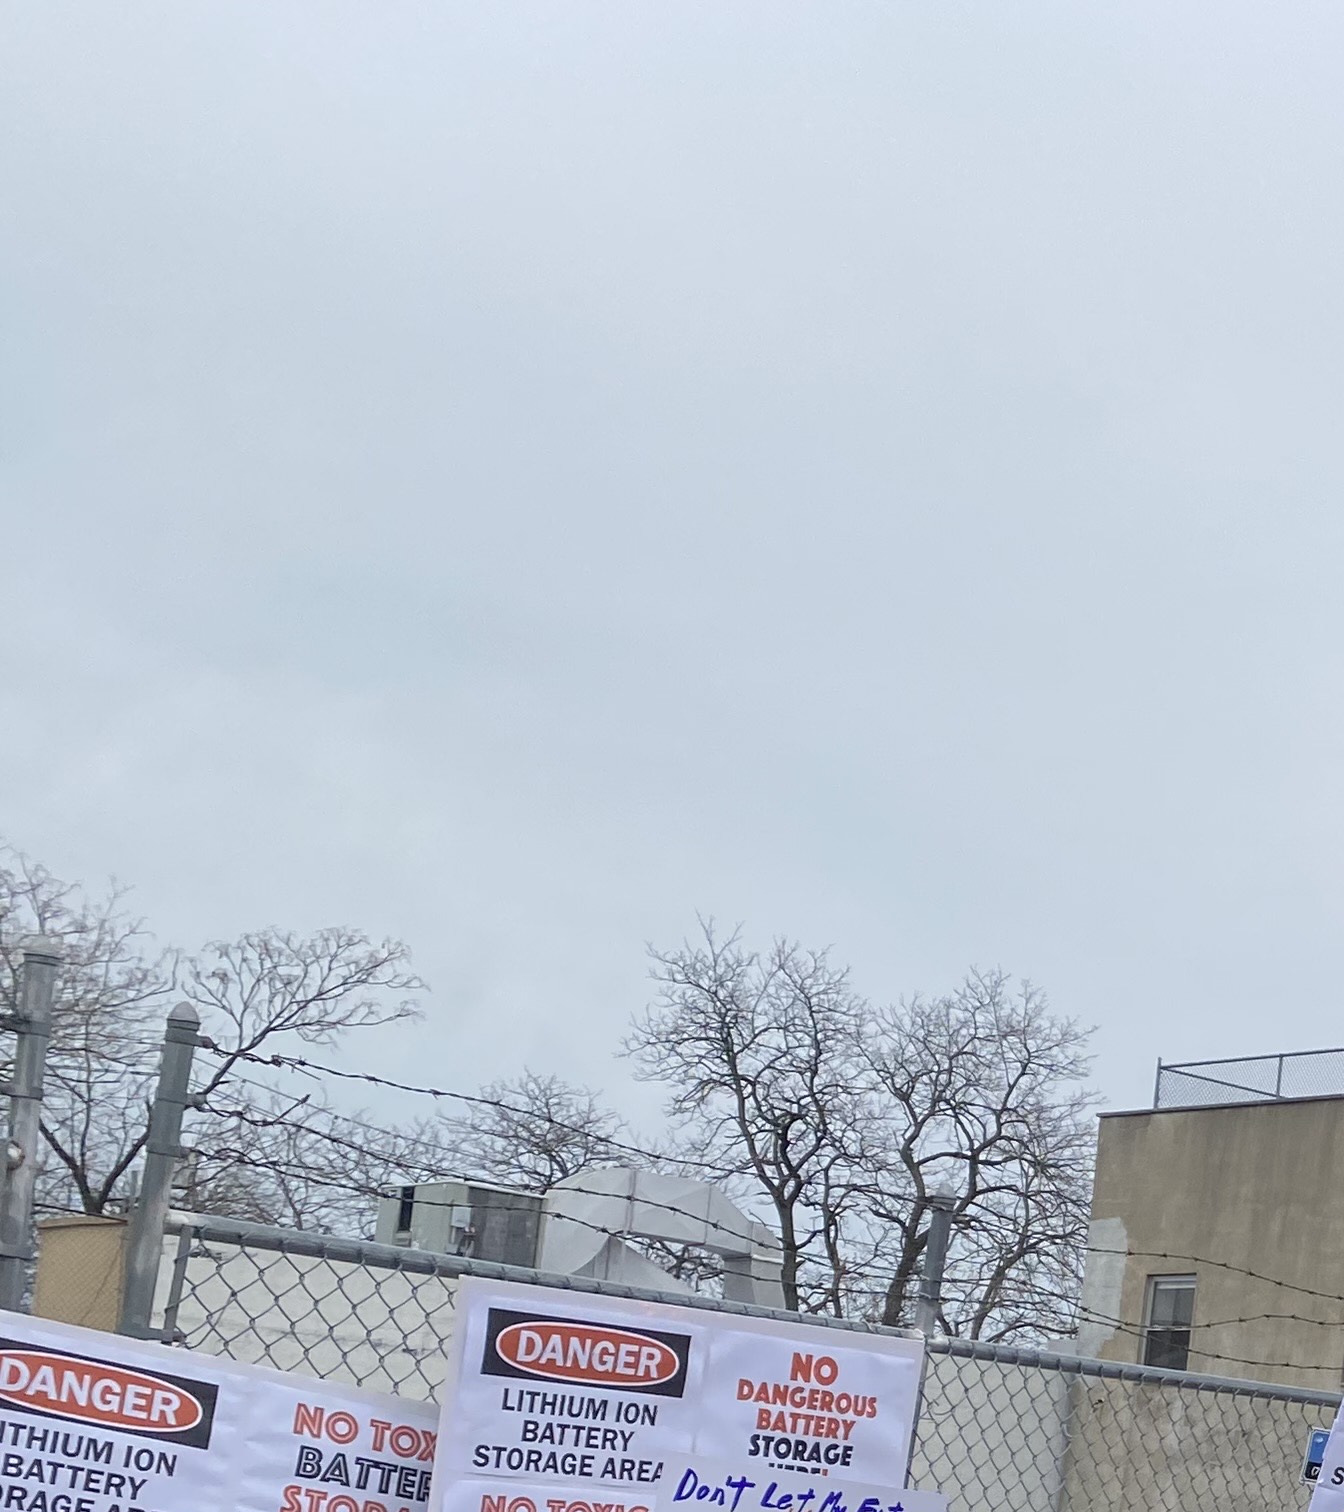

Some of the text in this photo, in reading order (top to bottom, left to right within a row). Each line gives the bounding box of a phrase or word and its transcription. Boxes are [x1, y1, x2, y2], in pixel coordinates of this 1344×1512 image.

[516, 1330, 662, 1378] DANGER
[790, 1352, 838, 1386] NO
[0, 1357, 181, 1425] DANGER
[501, 1388, 658, 1426] LITHIUM ION
[736, 1378, 877, 1418] DANGEROUS
[293, 1403, 438, 1463] NO TOX
[521, 1420, 635, 1452] BATTERY
[756, 1408, 856, 1441] BATTERY
[123, 1445, 177, 1476] ION
[472, 1445, 595, 1477] STORAGE
[748, 1434, 854, 1467] STORAGE
[1, 1453, 147, 1500] BATTERY
[673, 1468, 755, 1512] Don't
